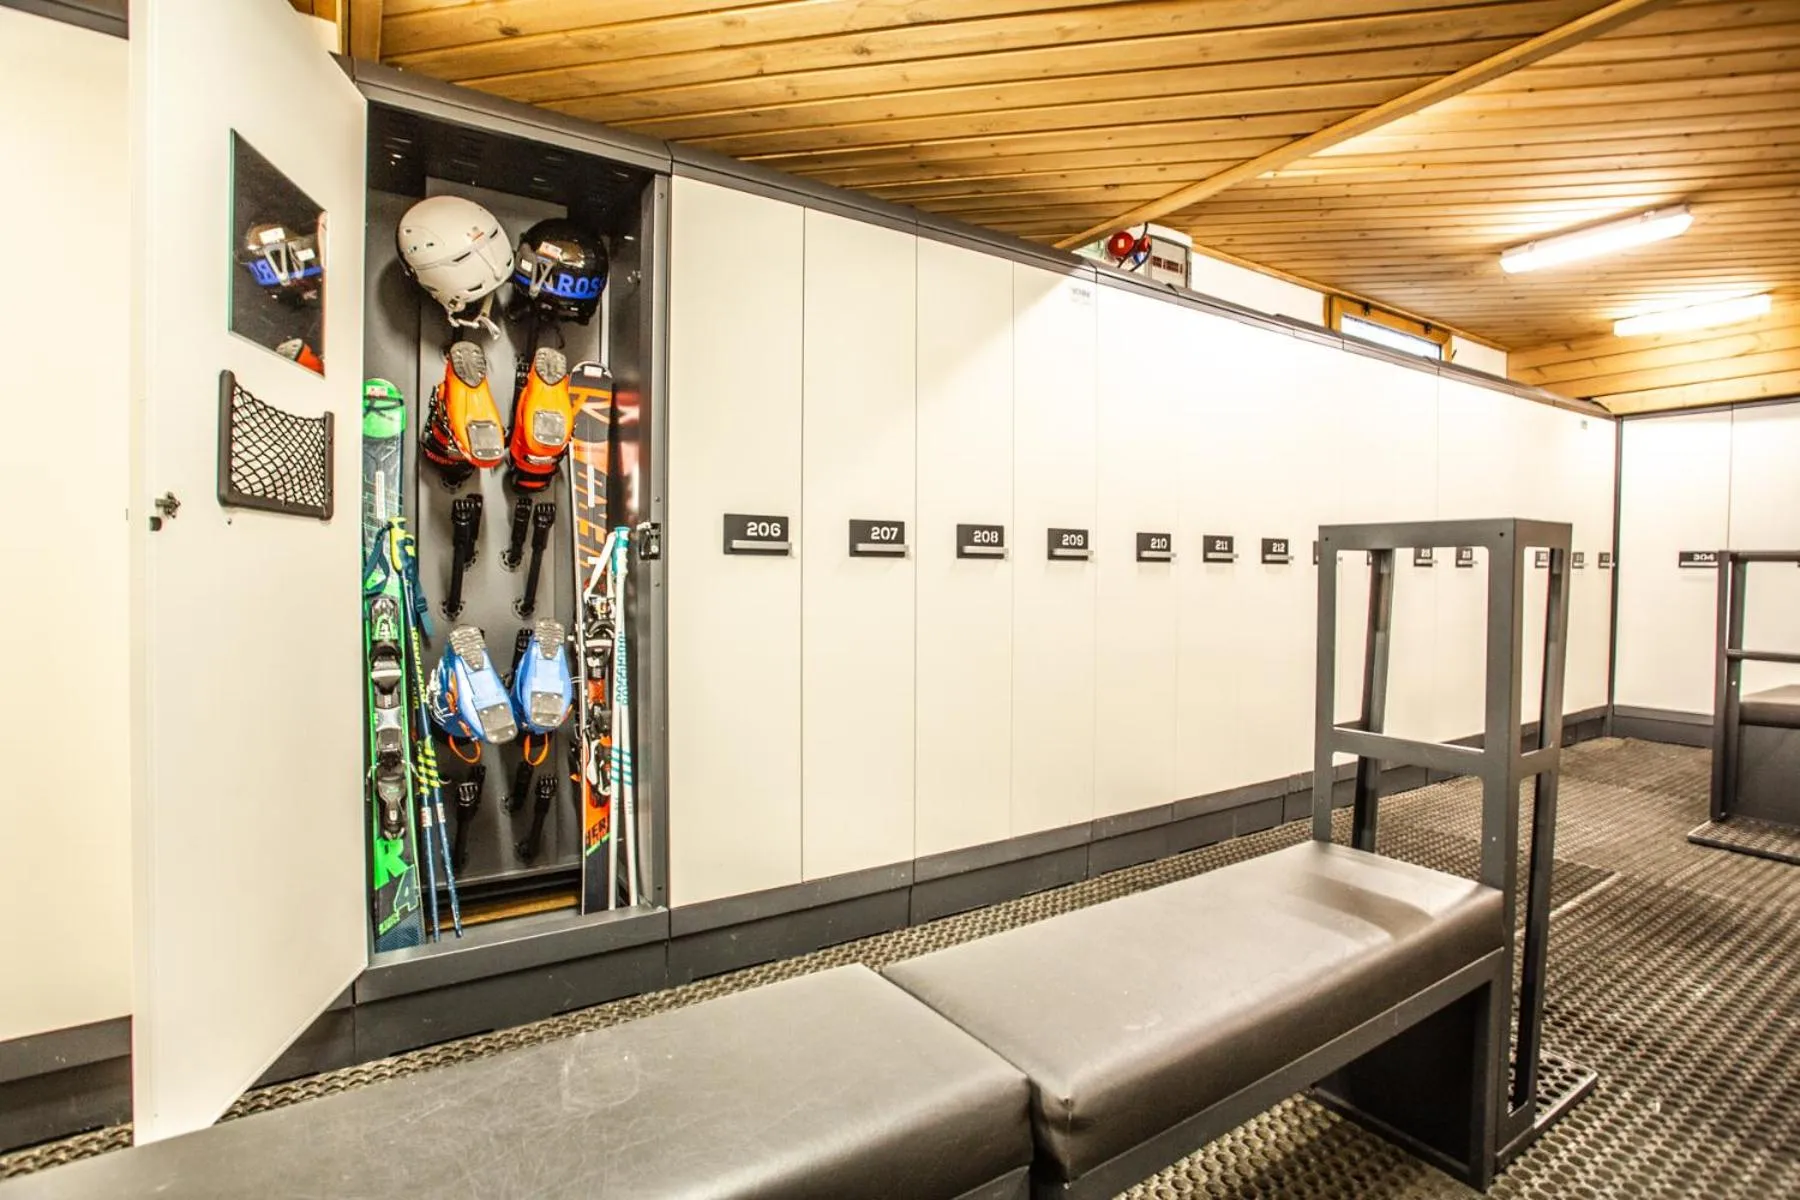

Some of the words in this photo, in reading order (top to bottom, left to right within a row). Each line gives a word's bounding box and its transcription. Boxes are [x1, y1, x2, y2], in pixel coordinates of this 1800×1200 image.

[746, 521, 782, 538] 206
[870, 526, 899, 541] 207
[973, 530, 999, 544] 208
[1061, 534, 1085, 547] 209
[1150, 537, 1167, 549] 210
[1214, 539, 1229, 551] 211
[1272, 542, 1286, 553] 212
[1693, 553, 1715, 561] 304
